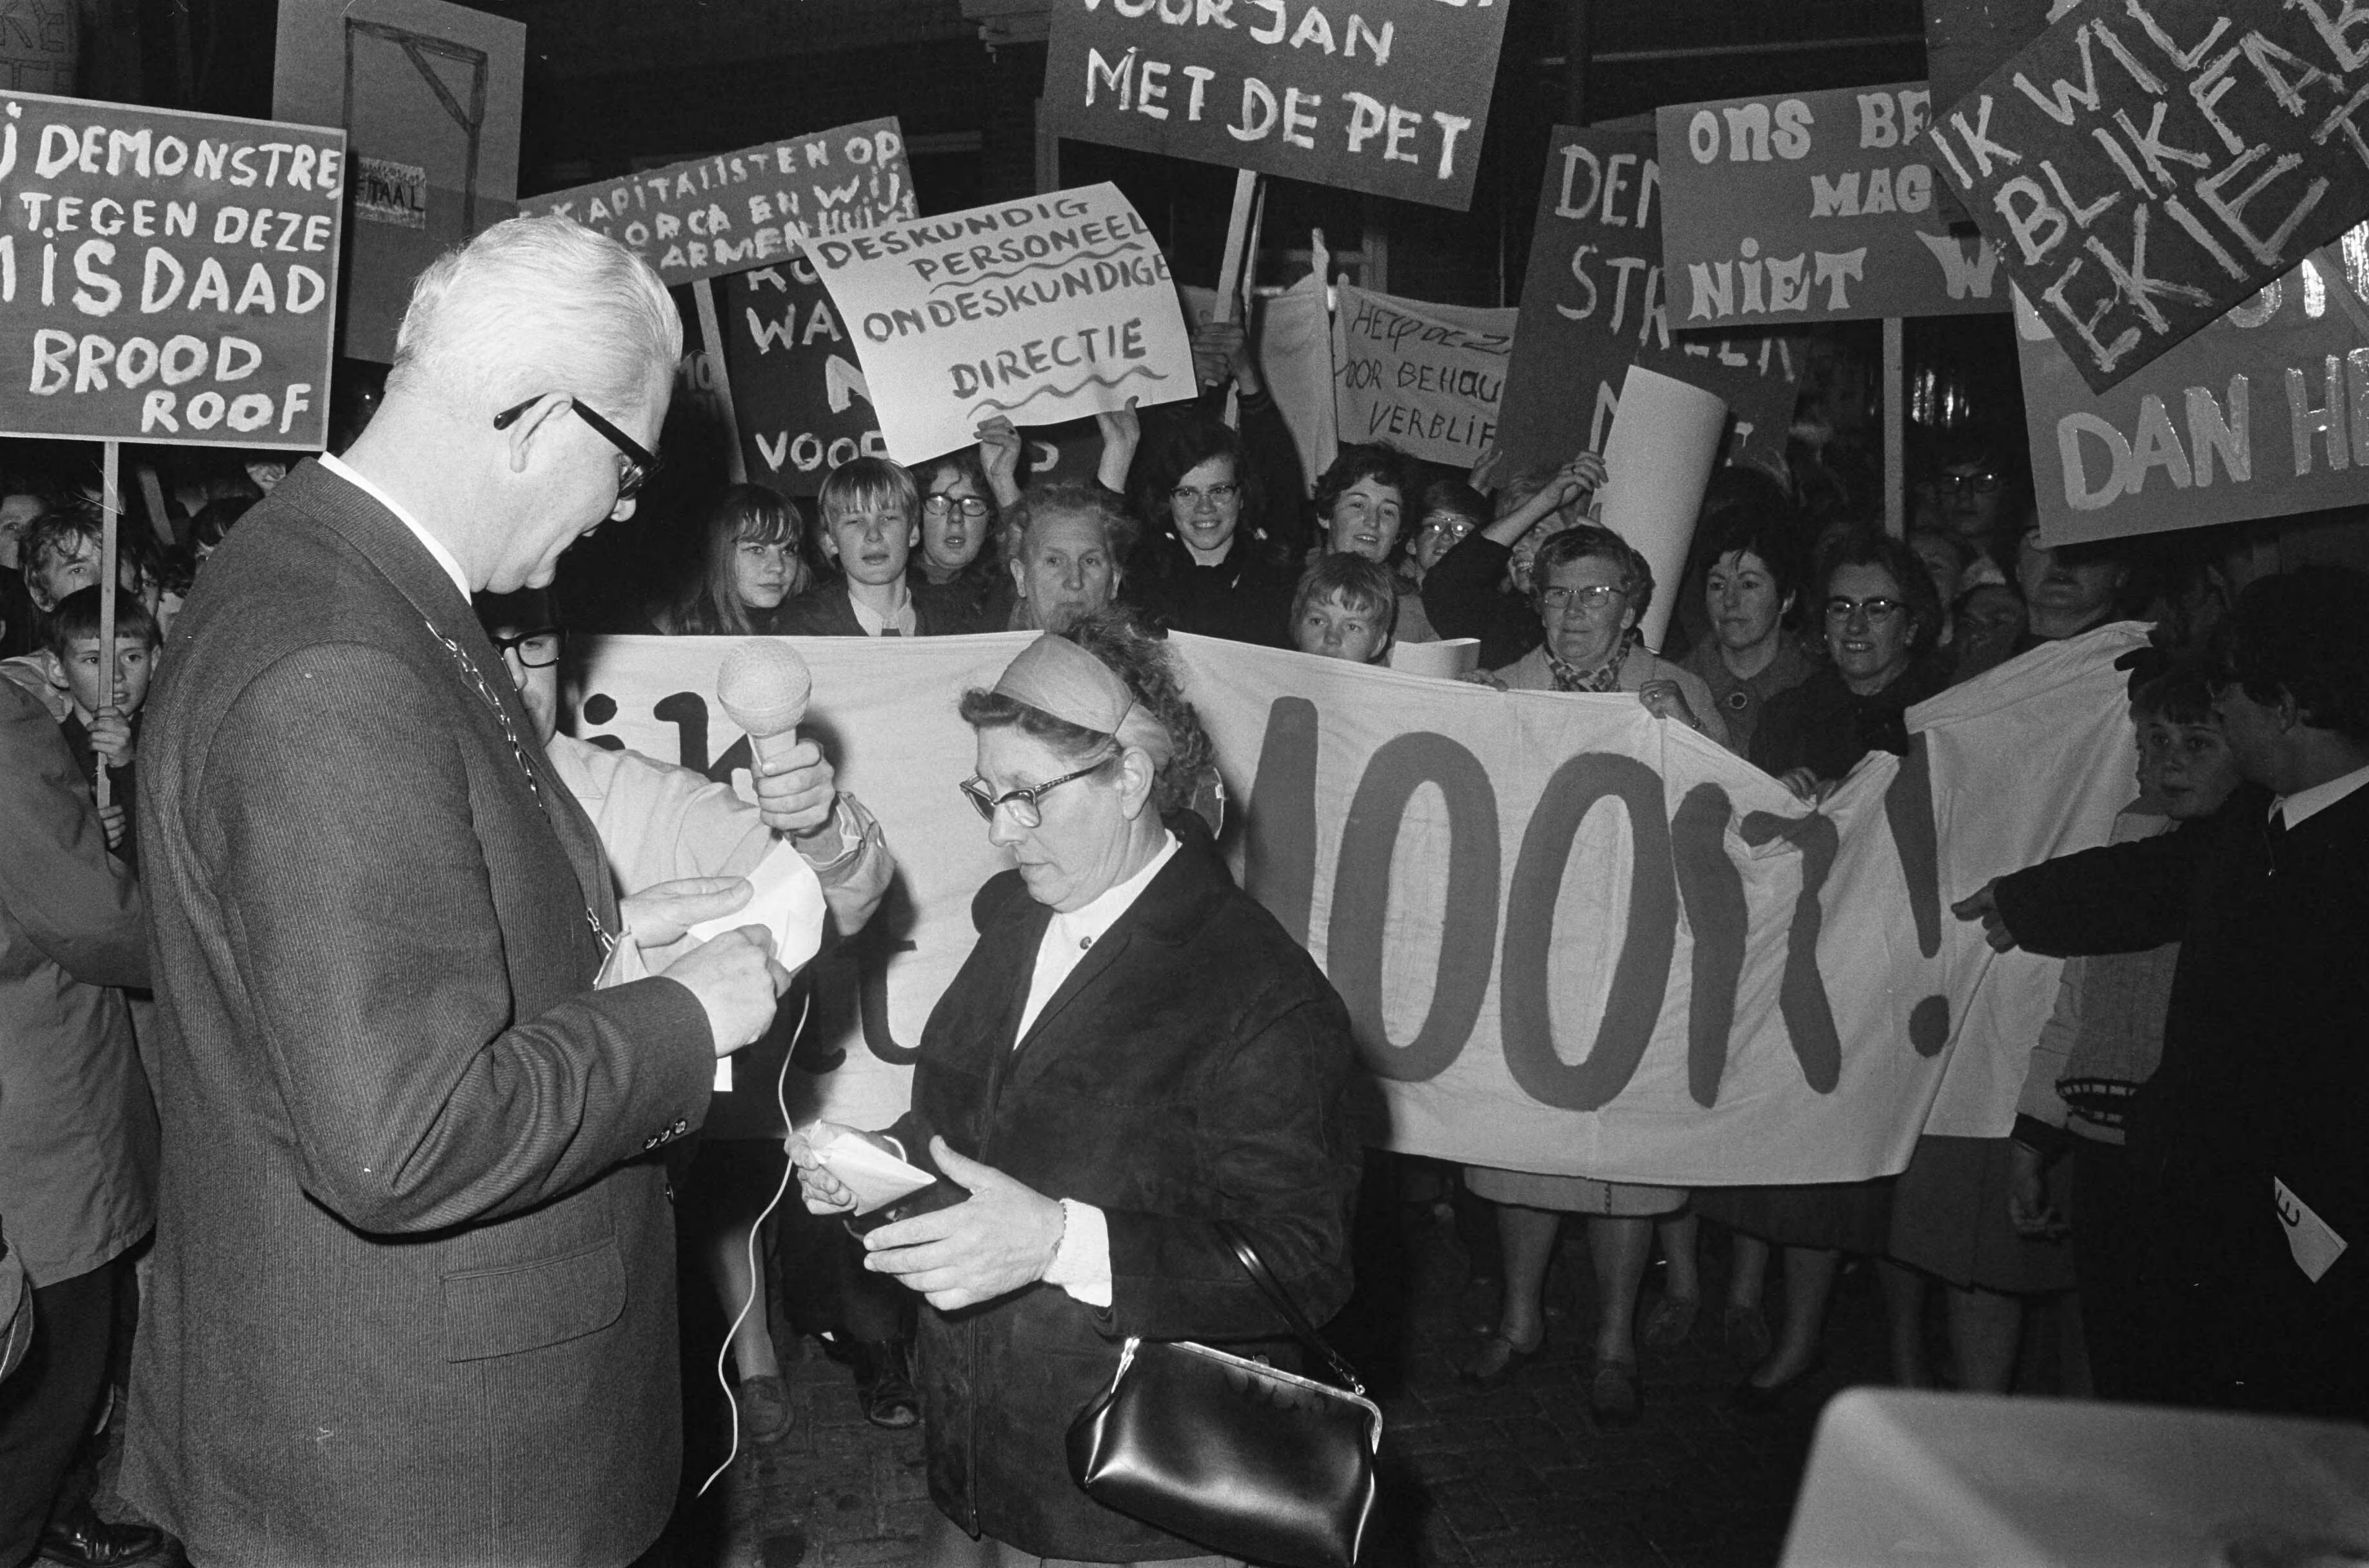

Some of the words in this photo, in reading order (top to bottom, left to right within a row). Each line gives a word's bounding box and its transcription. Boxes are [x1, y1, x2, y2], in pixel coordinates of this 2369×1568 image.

[1250, 0, 1393, 66] JAN
[1085, 47, 1216, 121] MET
[1227, 77, 1321, 149] DE
[1342, 92, 1471, 179] PET
[1856, 90, 1932, 149] BE
[1930, 95, 2022, 189] IK
[844, 130, 901, 170] OP
[19, 192, 197, 237] TEGEN
[213, 206, 332, 252] DEZE
[748, 190, 799, 224] EN
[1810, 164, 1932, 219] MAG
[817, 199, 1090, 270] DESKUNDIG
[907, 212, 1149, 282] PERSONEEL
[1914, 230, 2002, 300] W
[746, 299, 842, 355] WA
[863, 253, 1172, 342] ONDESKUNDIGE
[29, 328, 263, 395] BROOD
[948, 317, 1147, 399] DIRECTIE
[1397, 361, 1502, 403] BEHOU
[141, 383, 312, 433] ROOF
[2057, 373, 2252, 511] DAN
